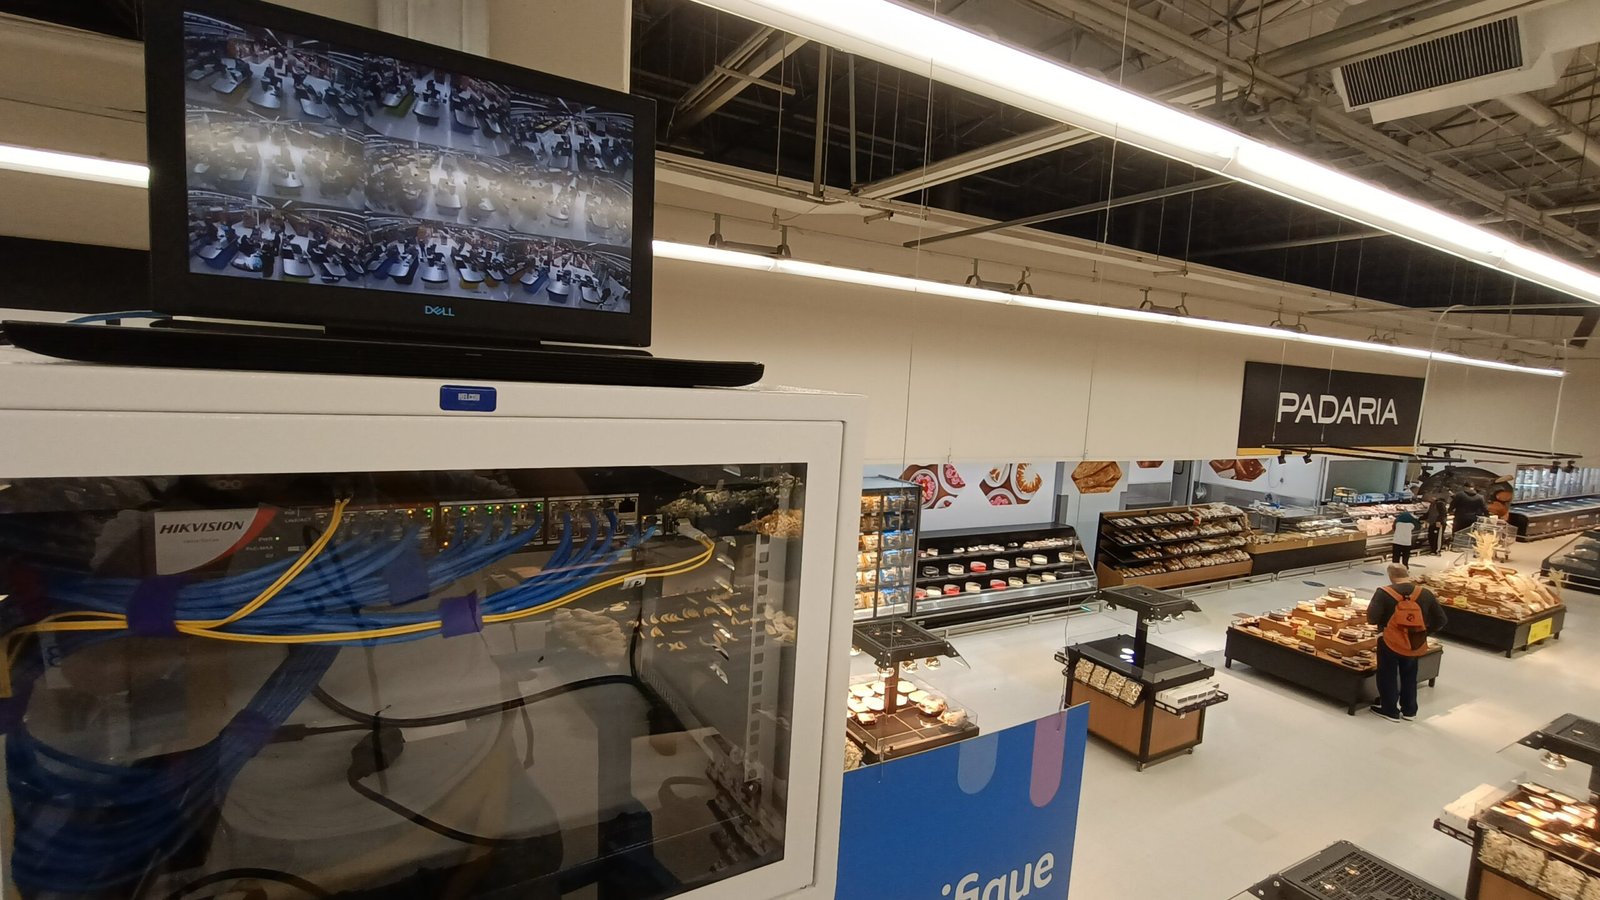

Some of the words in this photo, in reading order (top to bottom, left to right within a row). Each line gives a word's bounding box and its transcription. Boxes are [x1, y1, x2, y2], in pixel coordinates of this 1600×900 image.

[425, 305, 455, 317] DELL
[1277, 392, 1398, 425] PADARIA
[159, 521, 245, 534] HIKVISION
